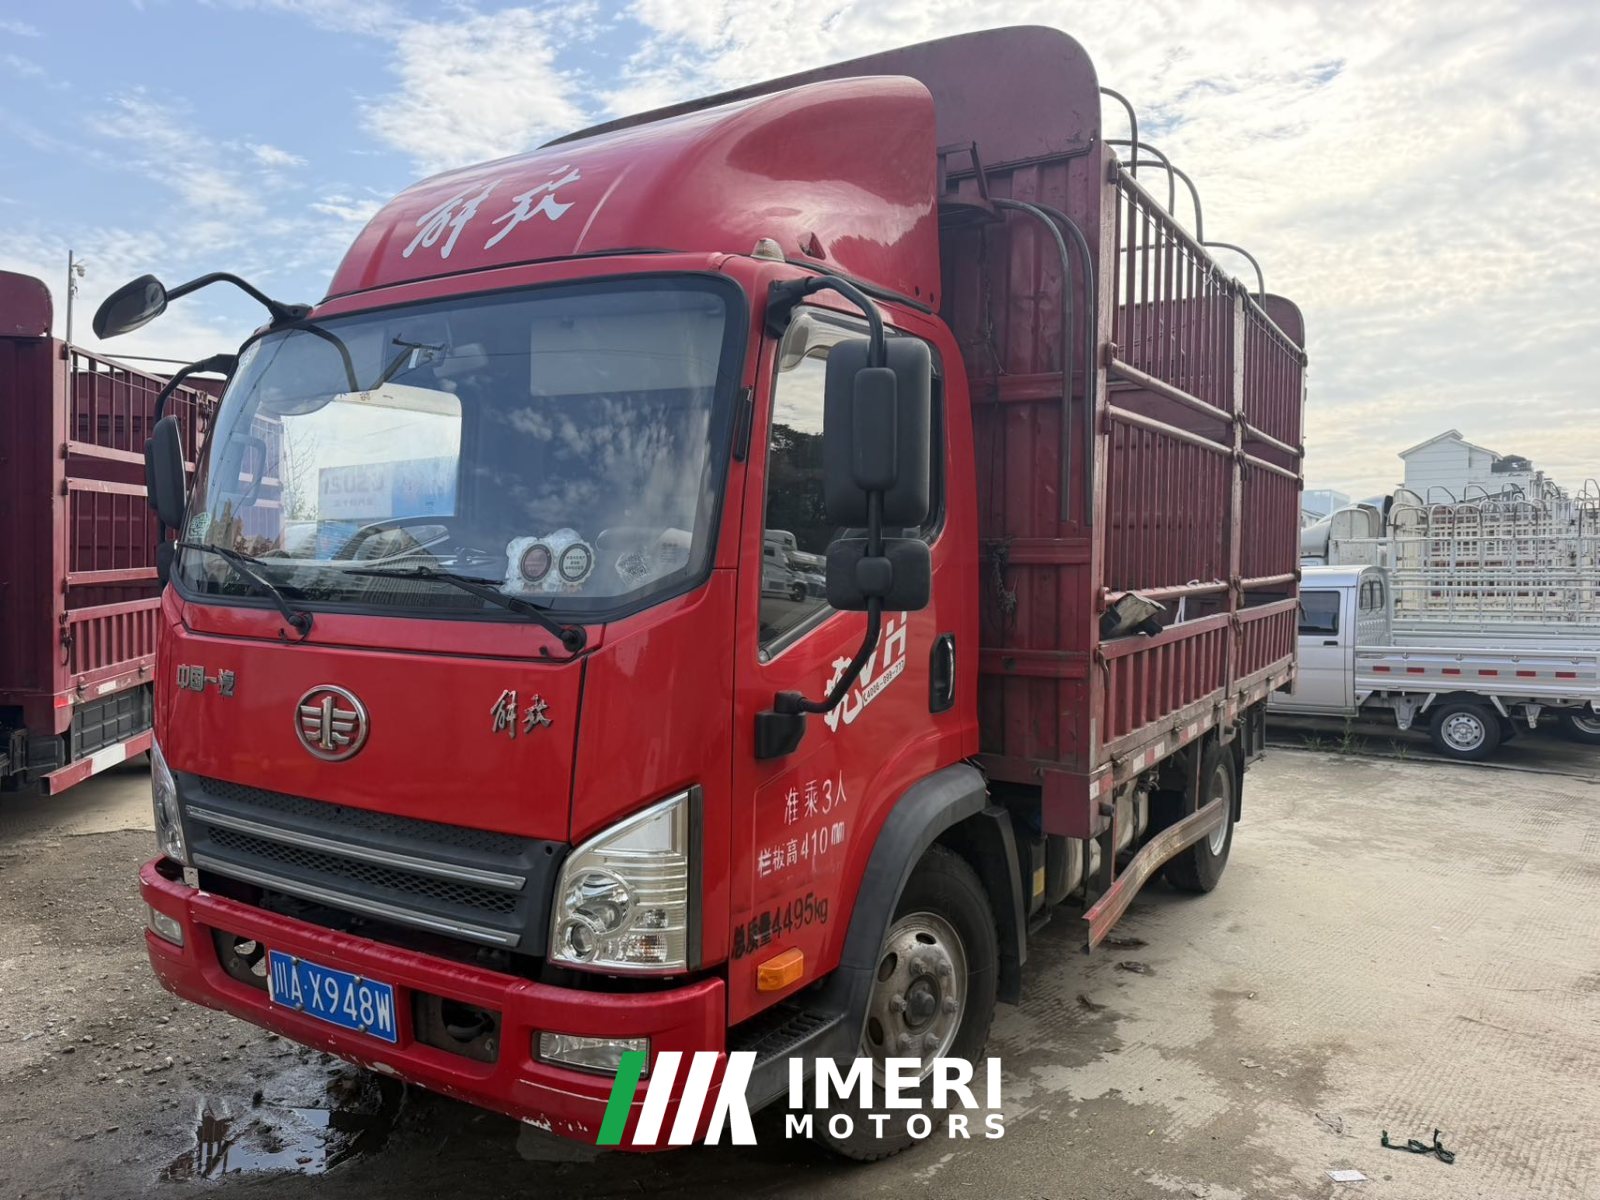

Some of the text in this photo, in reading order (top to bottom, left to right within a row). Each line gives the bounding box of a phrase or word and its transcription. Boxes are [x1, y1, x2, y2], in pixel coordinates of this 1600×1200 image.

[402, 164, 581, 259] 解放
[176, 664, 236, 697] 中国一汽
[489, 689, 553, 739] 解放
